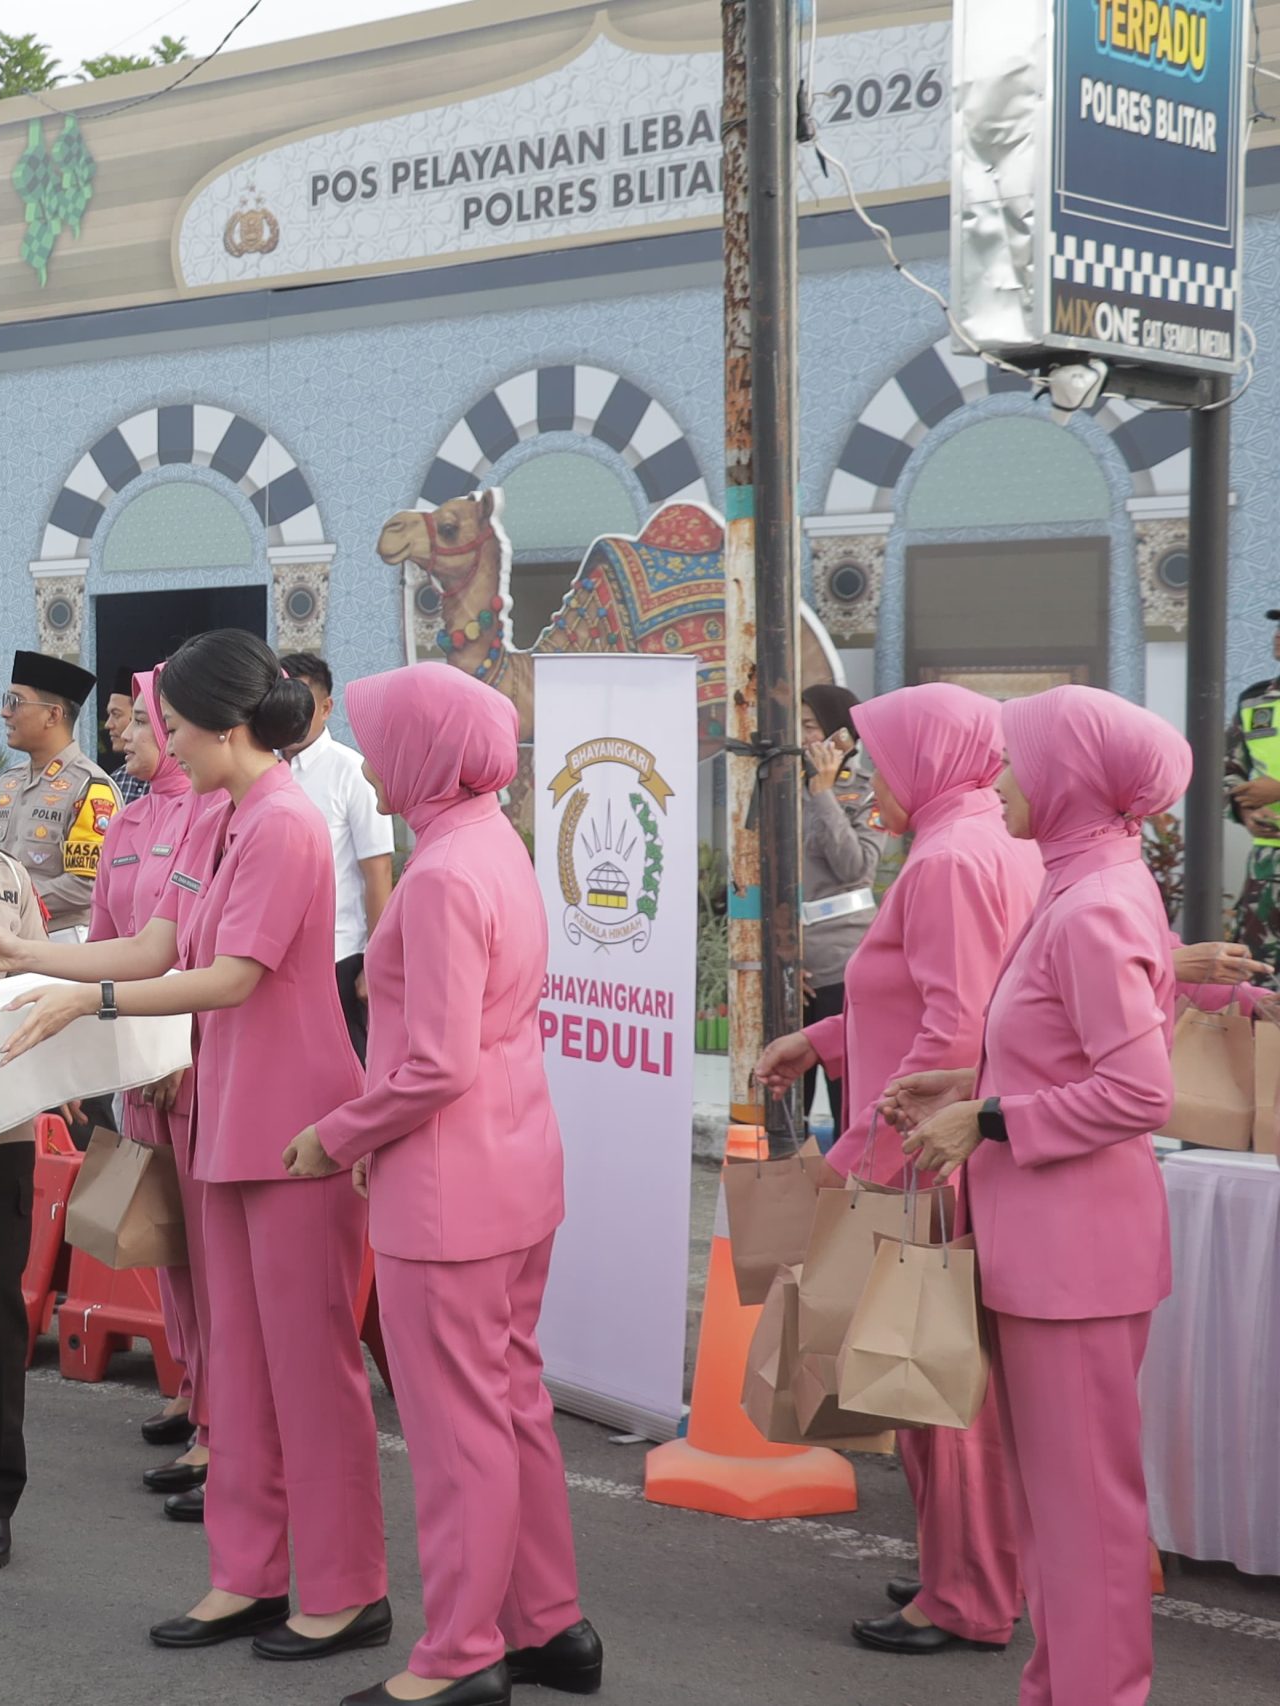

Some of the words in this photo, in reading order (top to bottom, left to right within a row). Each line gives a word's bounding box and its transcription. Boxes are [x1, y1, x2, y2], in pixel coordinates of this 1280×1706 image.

[1098, 0, 1207, 71] TERPADU
[311, 165, 377, 207] POS
[392, 127, 606, 194] PELAYANAN
[623, 109, 715, 157] LEBA
[828, 68, 943, 123] 2026
[1080, 77, 1152, 136] POLRES
[1155, 98, 1217, 153] BLITAR
[463, 177, 597, 231] POLRES
[613, 157, 724, 209] BLITA
[1054, 295, 1141, 347] MIXONE
[571, 741, 650, 774] BHAYANGKARI
[32, 808, 62, 822] POLRI
[65, 843, 102, 856] KASA
[574, 911, 608, 939] KEMALA
[608, 918, 642, 940] HIKMAH
[538, 1009, 673, 1077] PEDULI
